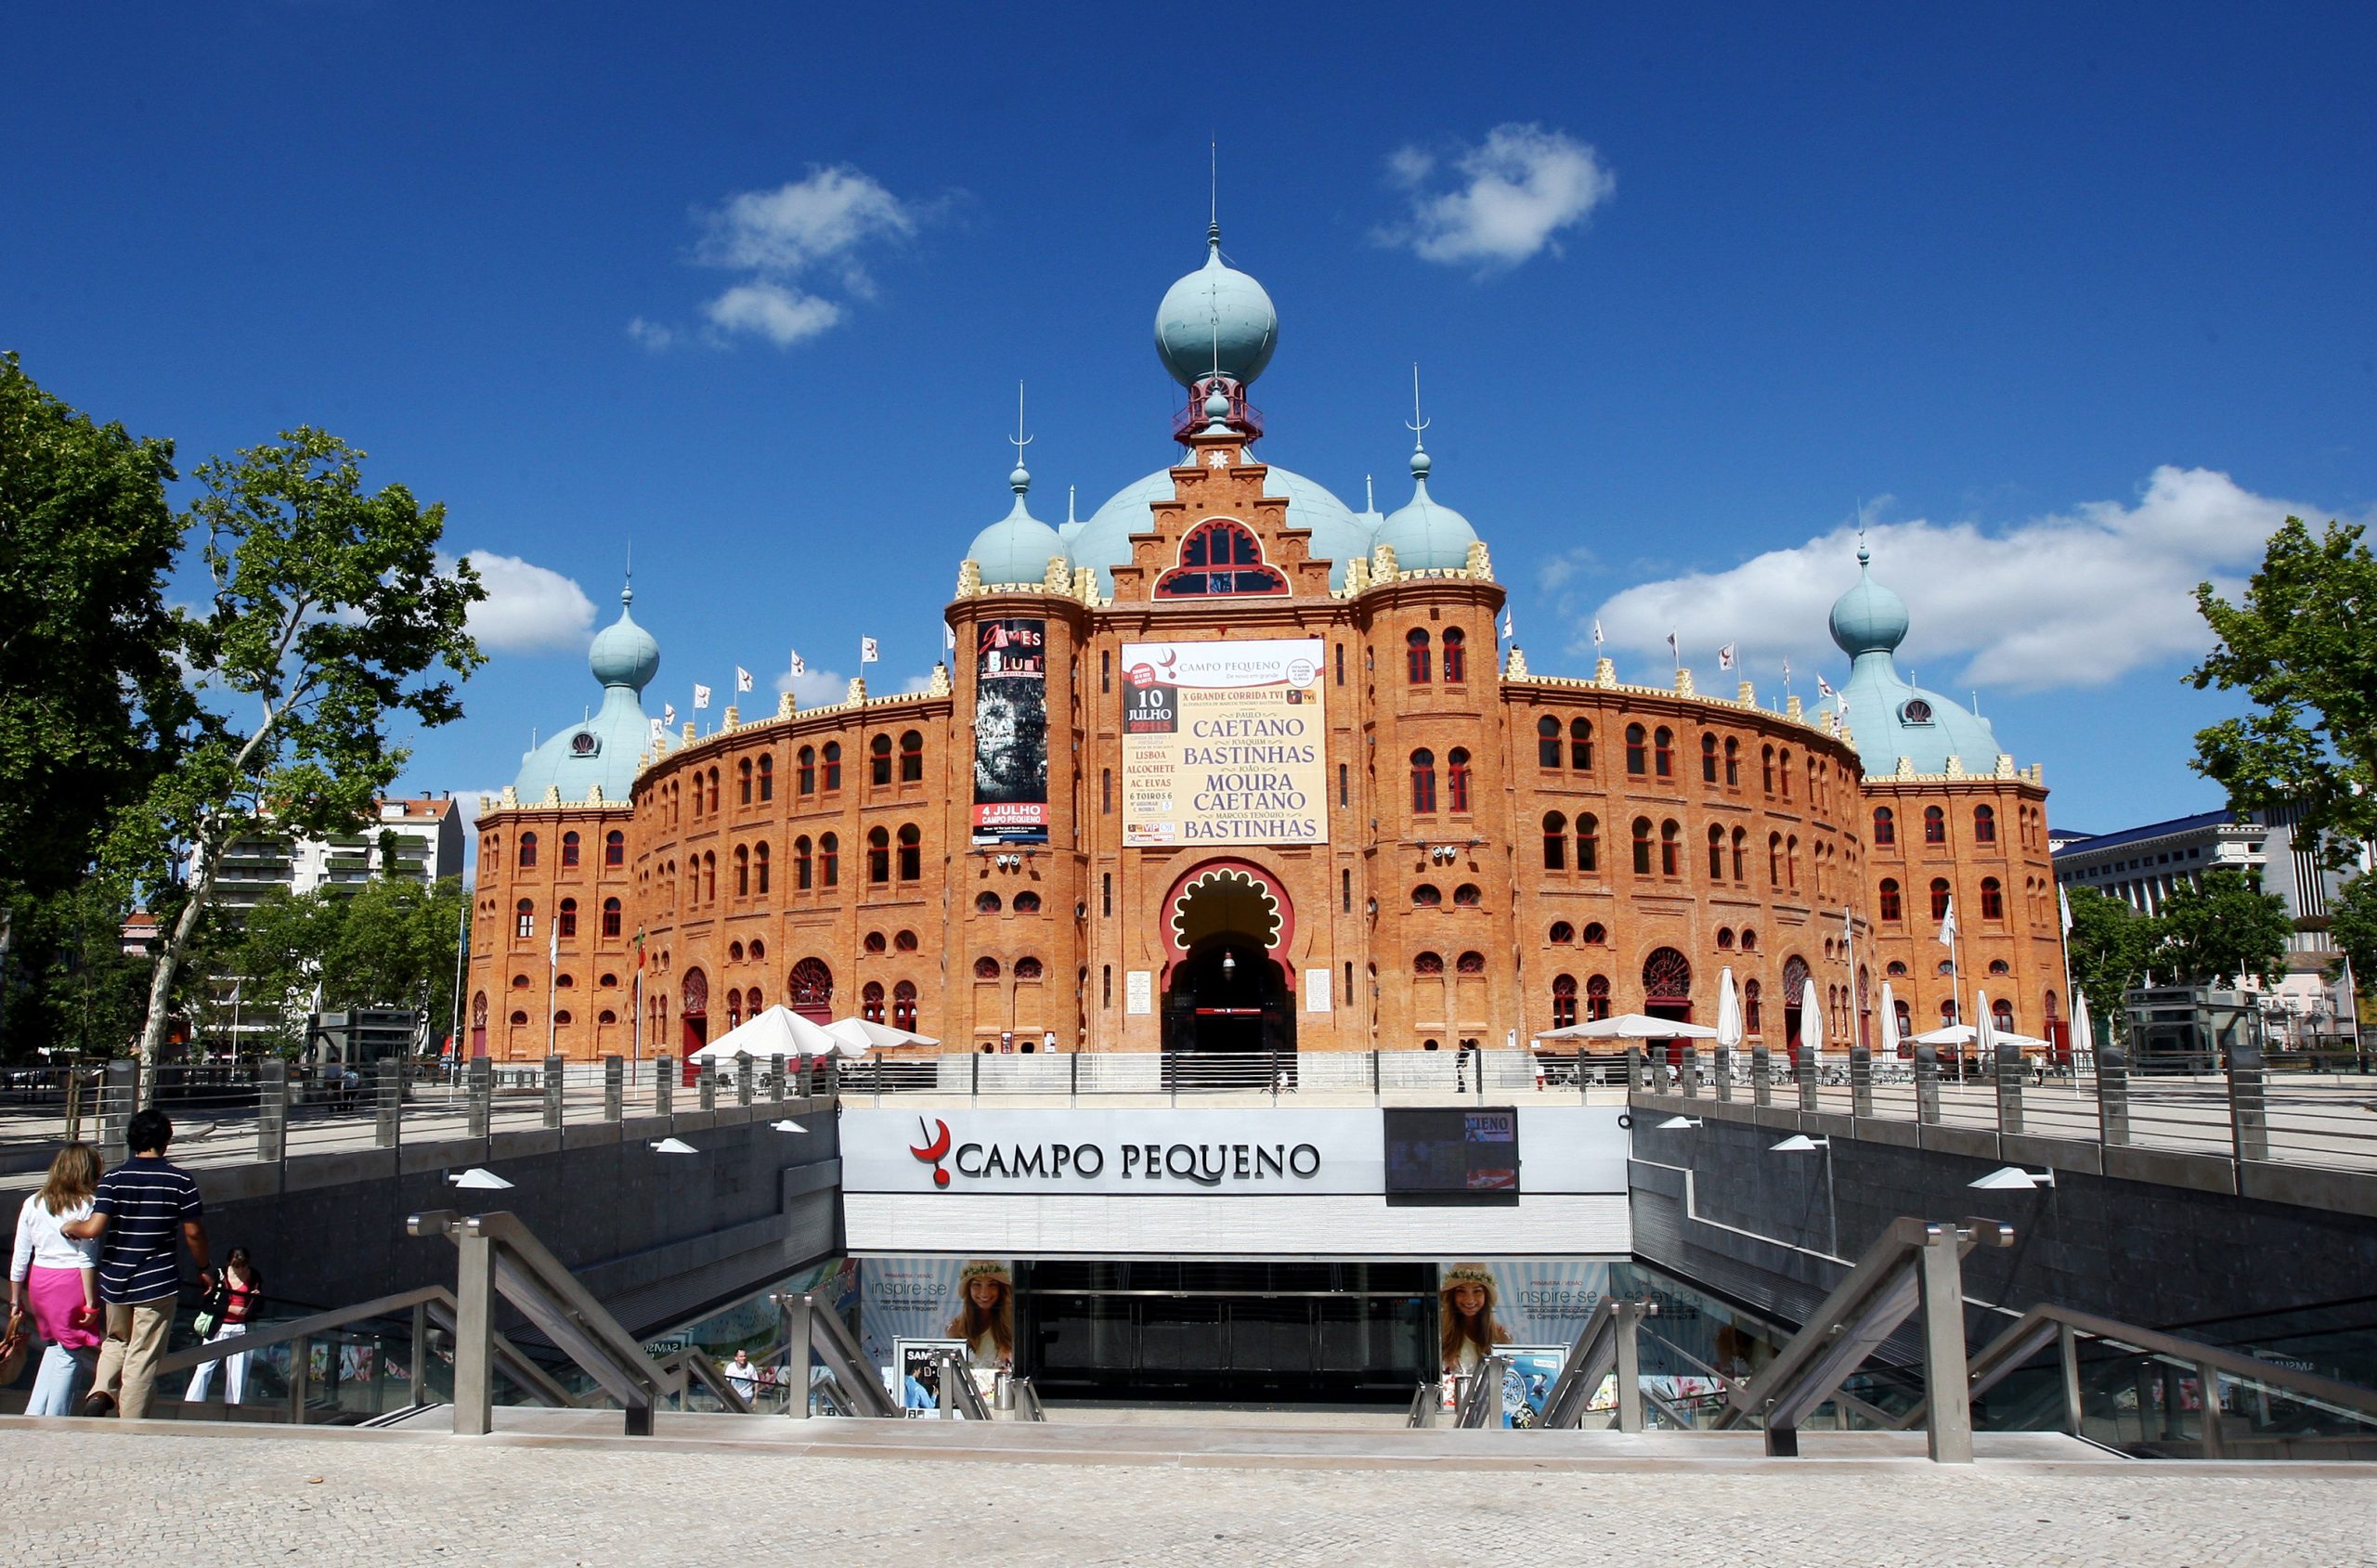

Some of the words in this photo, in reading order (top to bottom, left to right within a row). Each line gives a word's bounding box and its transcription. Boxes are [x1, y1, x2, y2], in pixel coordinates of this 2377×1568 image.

[979, 624, 1041, 655] JAMES
[1180, 662, 1221, 672] CAMPO
[1226, 661, 1280, 672] PEQUENO
[1138, 690, 1163, 708] 10
[1183, 693, 1188, 701] X
[1190, 692, 1227, 701] GRANDE
[1227, 691, 1266, 700] CORRIDA
[1269, 691, 1284, 699] TVI
[1128, 708, 1172, 721] JULHO
[1193, 719, 1305, 738] CAETANO
[1136, 751, 1166, 759] LISBOA
[1184, 745, 1315, 765] BASTINHAS
[1127, 765, 1176, 773] ALCOCHETE
[1131, 779, 1143, 787] AC.
[1145, 779, 1172, 787] ELVAS
[1205, 773, 1294, 792] MOURA
[982, 806, 991, 816] 4
[994, 805, 1041, 816] JULHO
[1193, 792, 1306, 811] CAETANO
[982, 816, 1006, 824] CAMPO
[1007, 815, 1041, 823] PEQUENO
[1144, 823, 1160, 832] VIP
[1184, 819, 1317, 838] BASTINHAS
[955, 1143, 1104, 1179] CAMPO
[1121, 1143, 1320, 1186] PEQUENO
[872, 1279, 946, 1298] inspire-se
[1516, 1287, 1597, 1306] inspire-se
